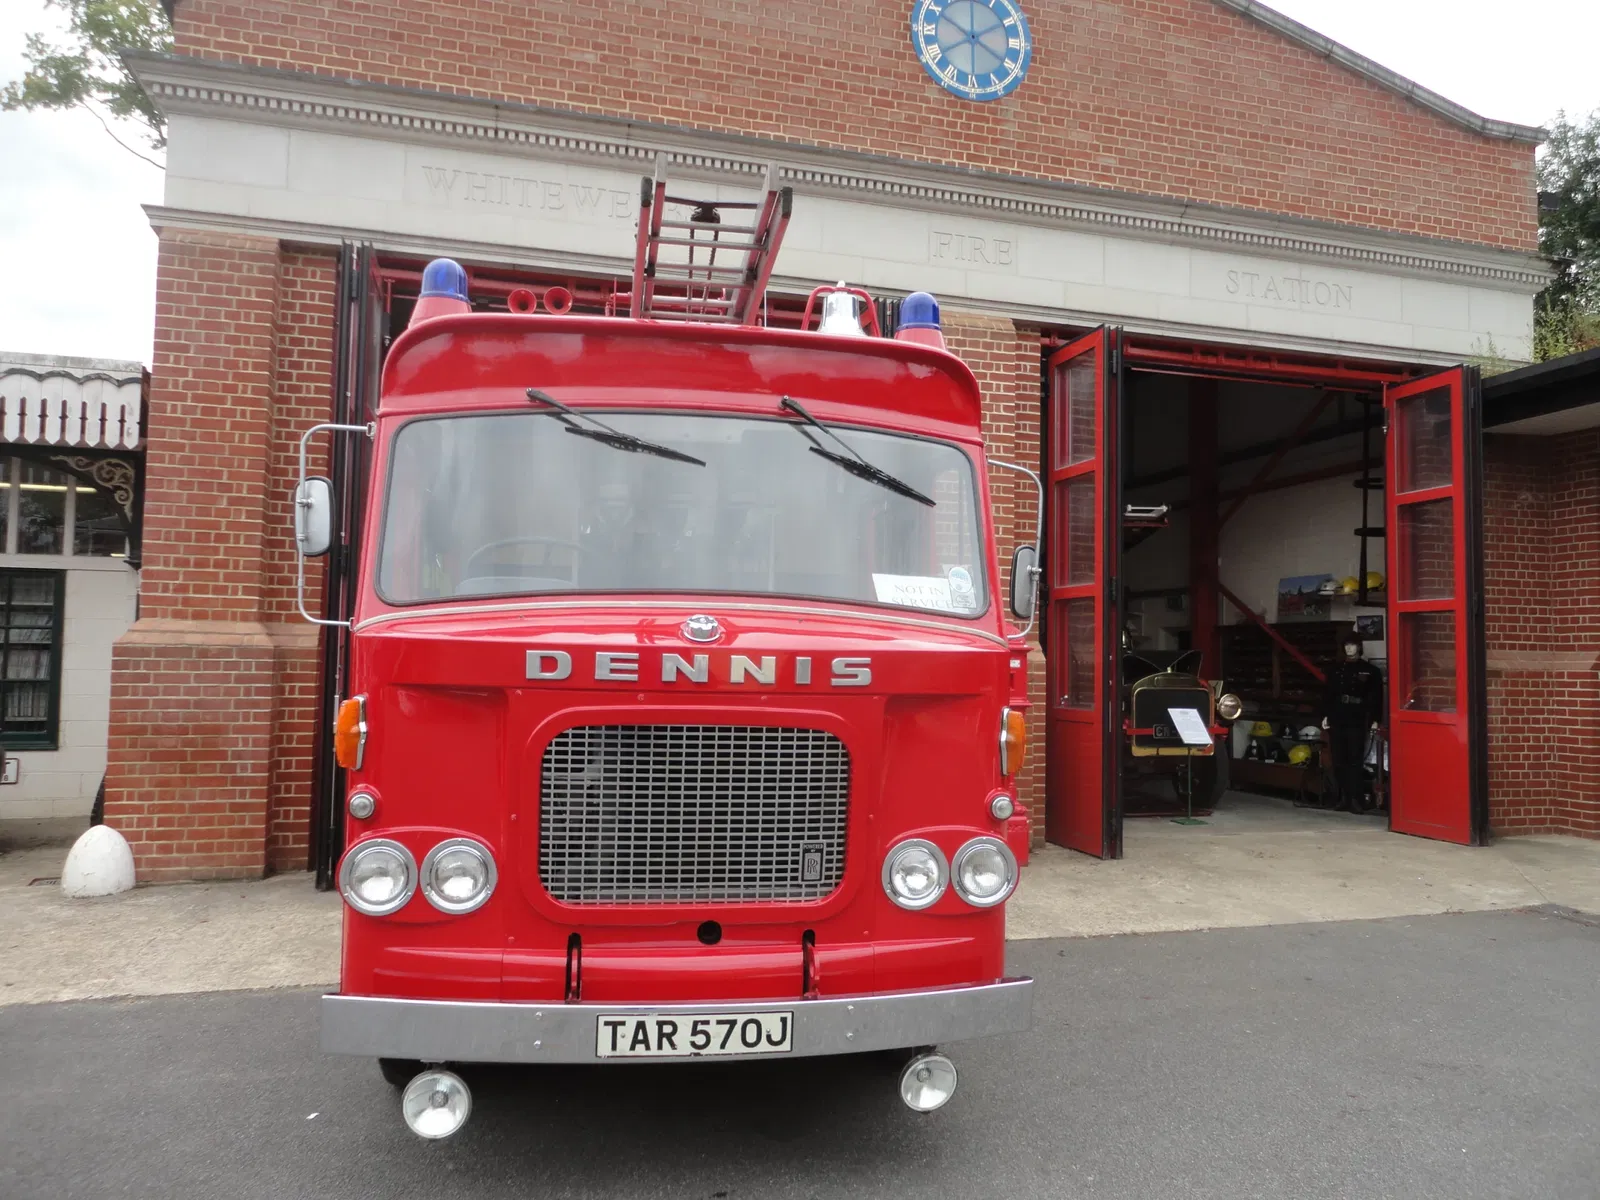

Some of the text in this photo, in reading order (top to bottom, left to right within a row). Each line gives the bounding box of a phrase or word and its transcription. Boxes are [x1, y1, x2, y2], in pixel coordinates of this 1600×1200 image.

[932, 231, 1354, 310] FIRE STATION
[894, 584, 945, 596] NOT IN
[525, 650, 872, 686] DENNIS
[603, 1016, 788, 1052] TAR 570J
